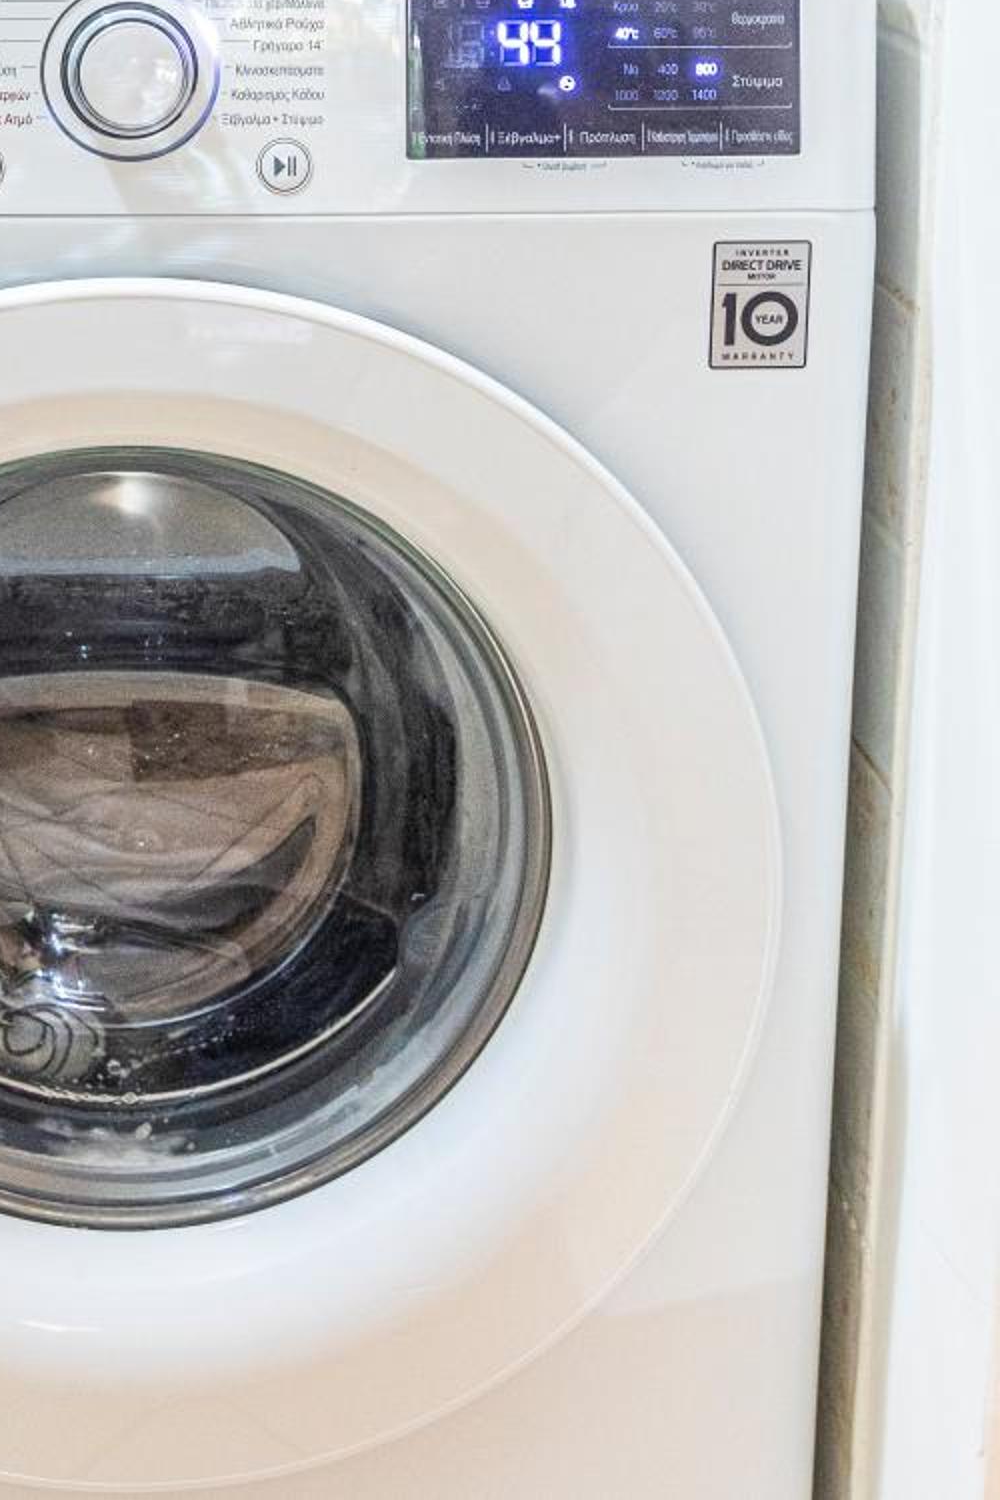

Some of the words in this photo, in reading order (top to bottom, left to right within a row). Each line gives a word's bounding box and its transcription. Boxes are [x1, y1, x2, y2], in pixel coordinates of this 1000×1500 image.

[721, 260, 765, 271] DIRECT
[766, 259, 802, 271] DRIVE
[721, 291, 799, 346] 10
[755, 313, 783, 324] YEAR
[721, 351, 795, 361] WARRANTY
